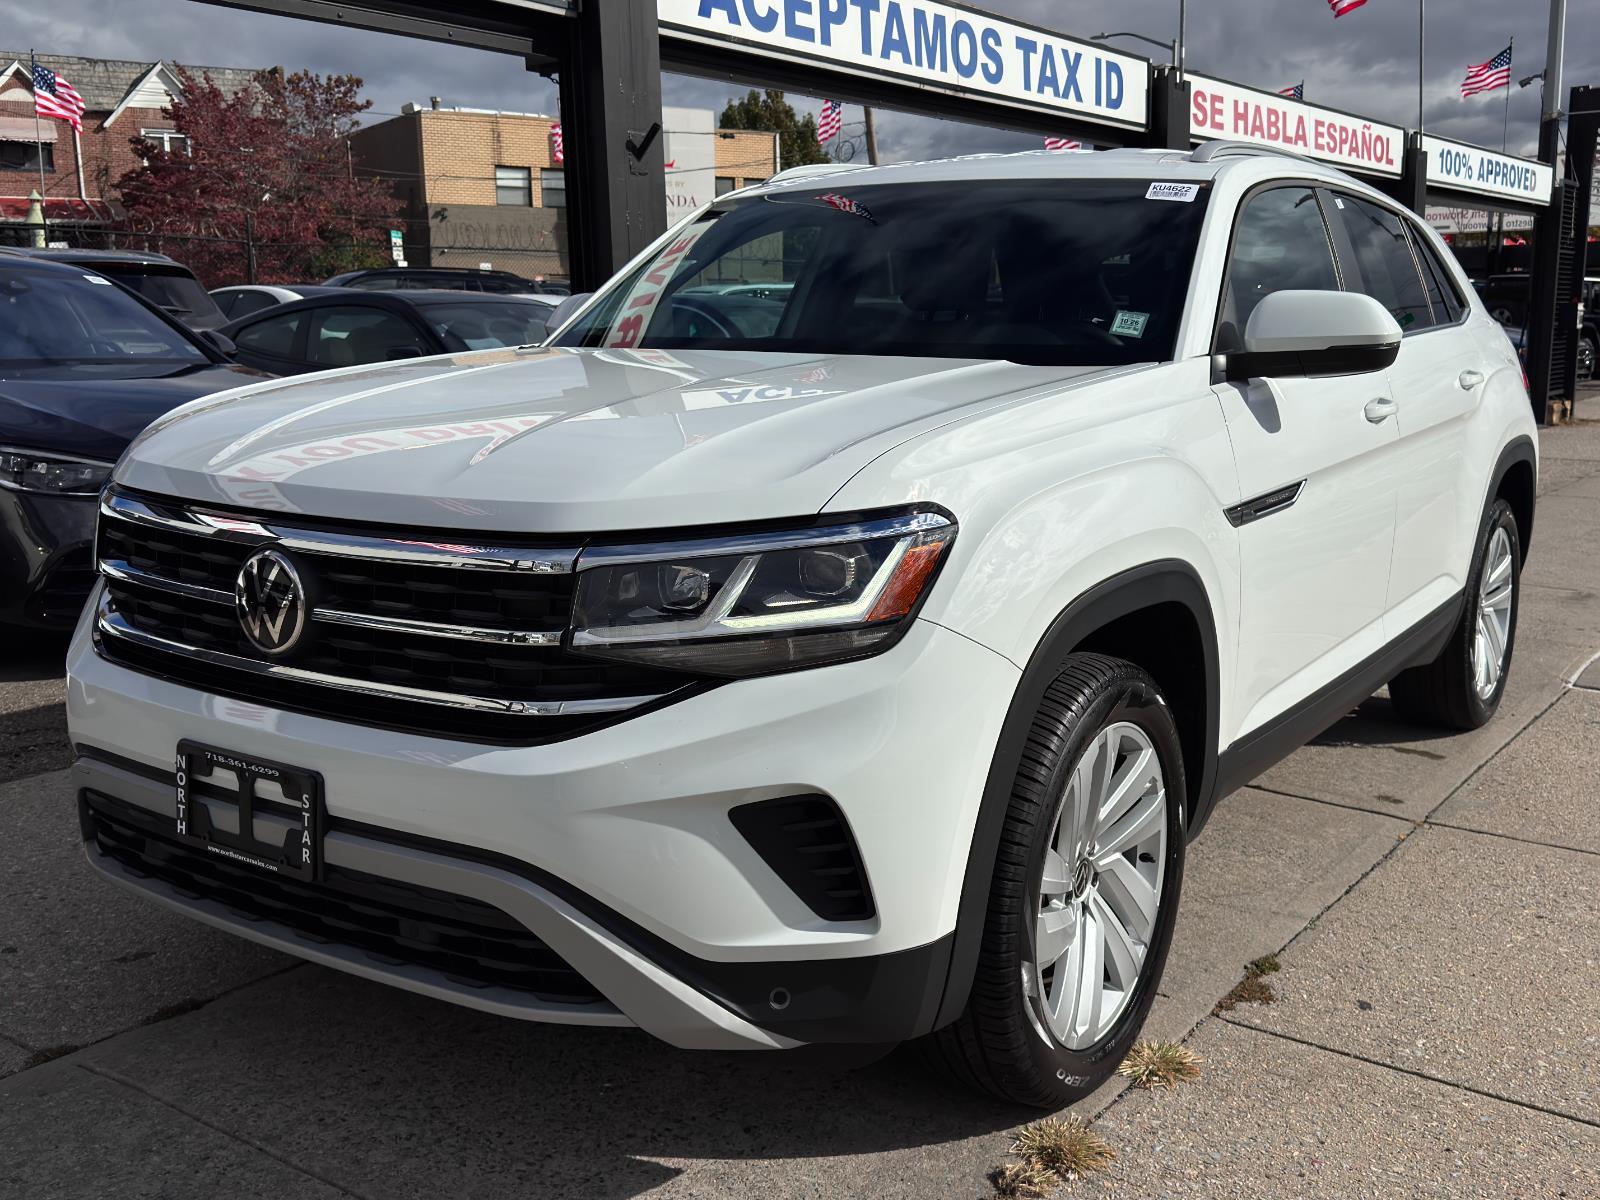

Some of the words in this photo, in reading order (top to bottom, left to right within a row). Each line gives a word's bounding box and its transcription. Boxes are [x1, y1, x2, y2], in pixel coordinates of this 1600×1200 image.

[697, 0, 1004, 86] ACEPTAMOS
[1015, 36, 1083, 102] TAX
[1094, 57, 1125, 110] ID
[1192, 89, 1225, 131] SE
[1233, 99, 1308, 147] HABLA
[1313, 119, 1394, 166] ESPAÑOL
[1151, 184, 1192, 193] KU4622
[1438, 147, 1474, 181] 100%
[1477, 156, 1538, 193] APPROVED
[204, 751, 280, 777] 718-361-6299
[176, 754, 187, 836] NORTH
[301, 793, 312, 864] STAR
[1056, 1068, 1090, 1088] ZERO
